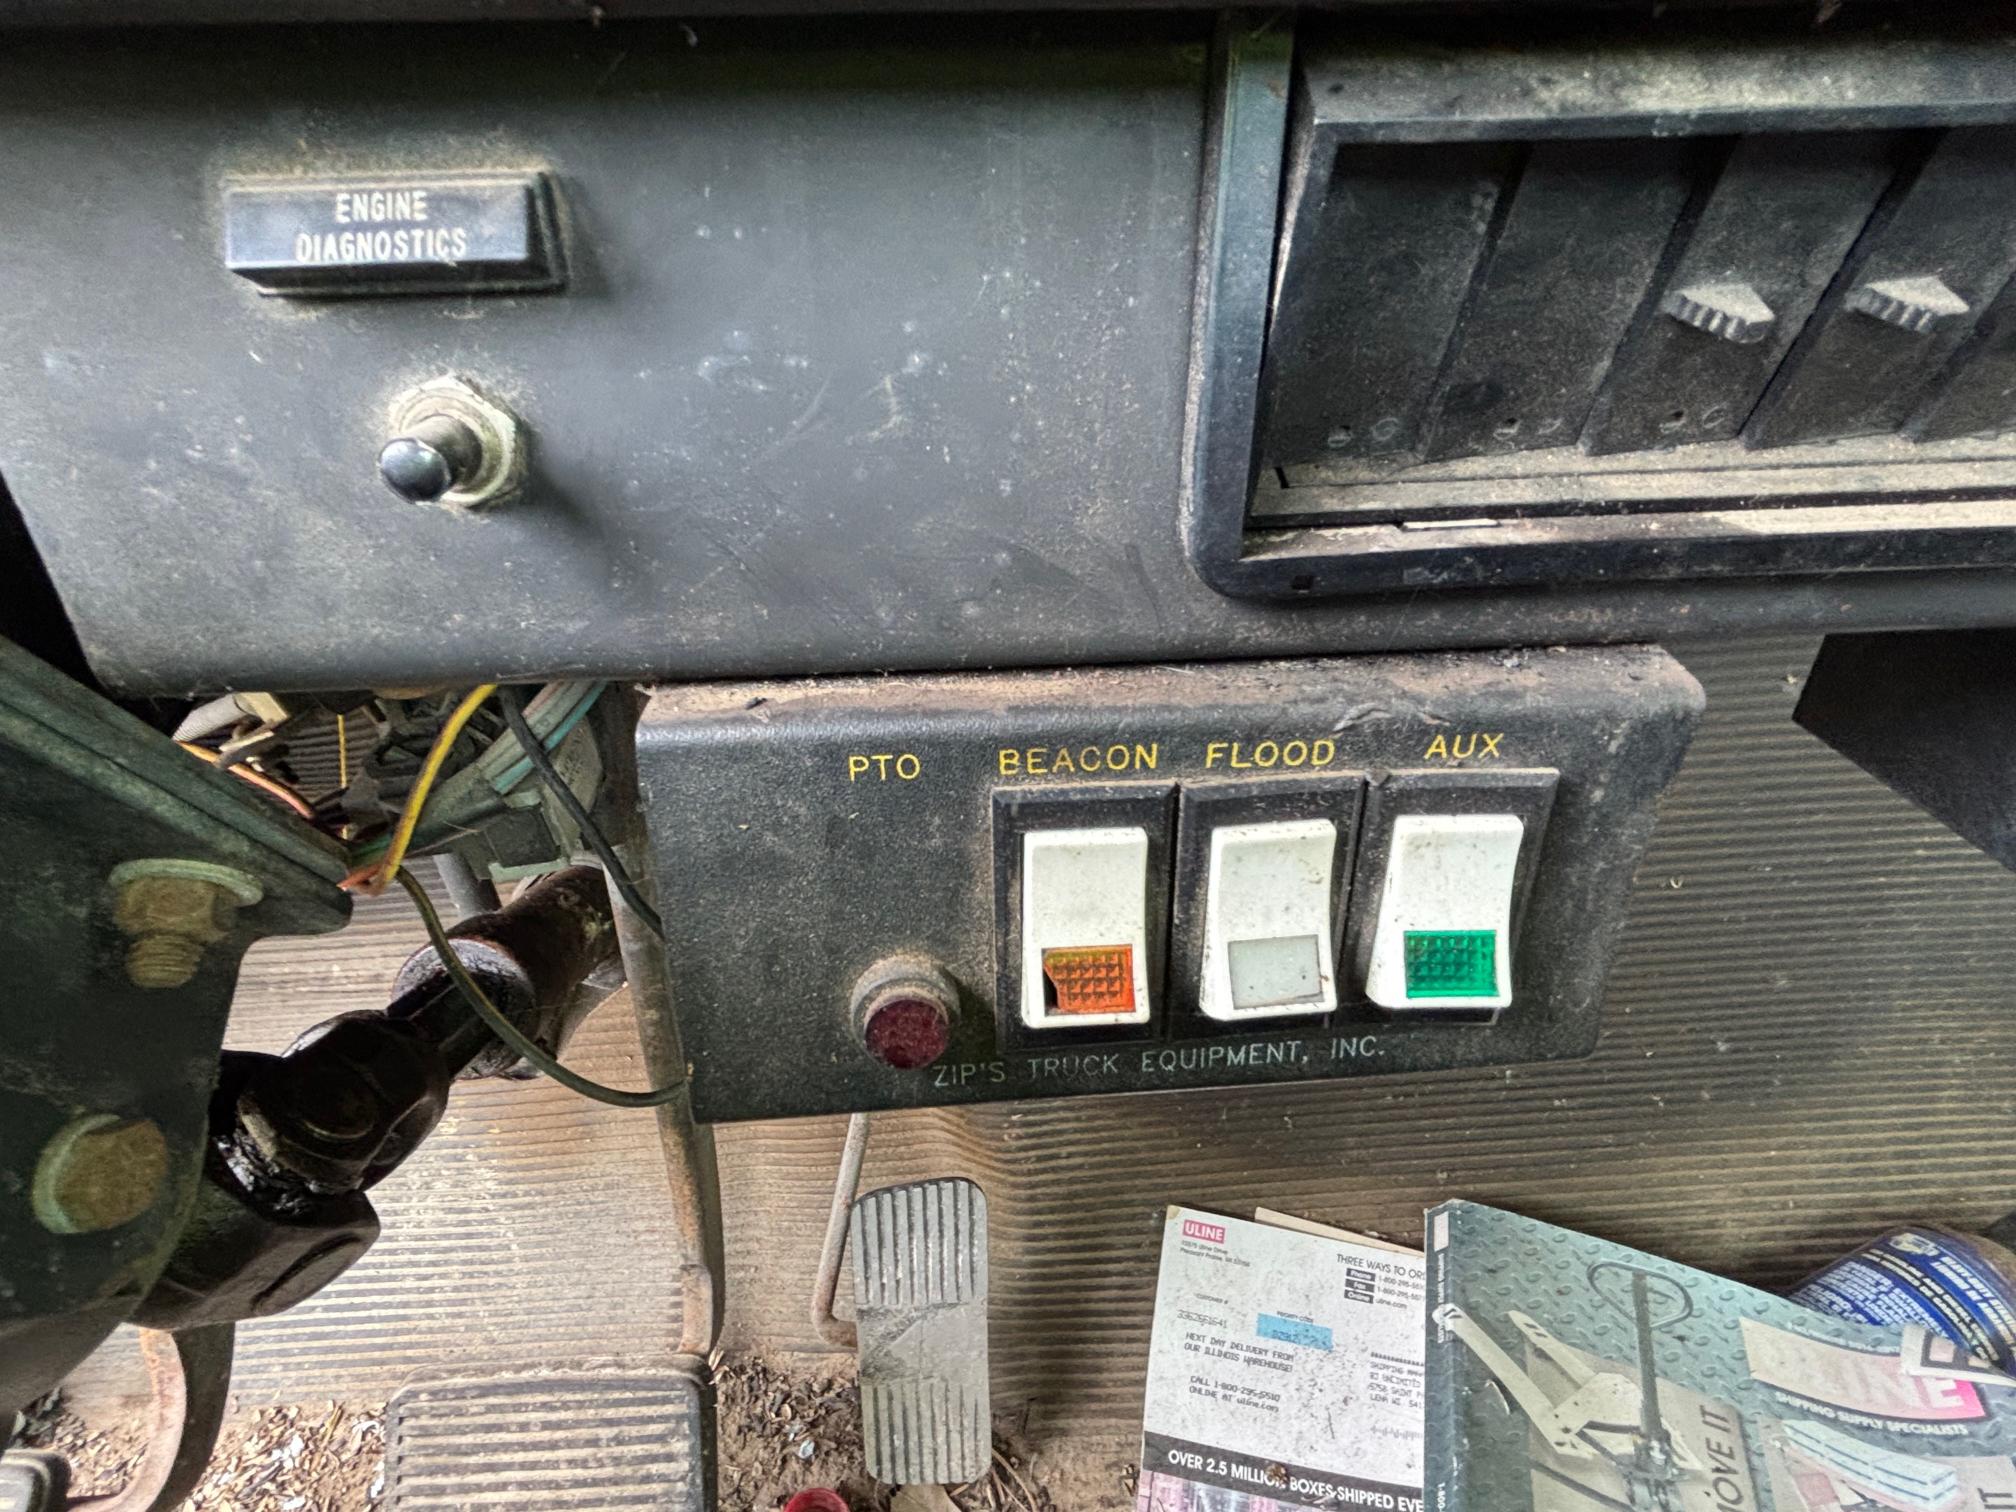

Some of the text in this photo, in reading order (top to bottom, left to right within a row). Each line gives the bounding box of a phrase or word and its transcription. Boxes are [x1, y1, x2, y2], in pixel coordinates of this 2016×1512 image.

[335, 190, 428, 224] ENGINE
[294, 227, 468, 264] DIAGNOSTICS
[999, 743, 1159, 776] BEACON
[1205, 738, 1336, 768] FLOOD
[1424, 732, 1504, 760] AUX
[849, 754, 921, 782] PTO
[933, 1036, 1386, 1088] ZIP'S TRUCK EQUIPMENT, INC.
[1184, 1221, 1224, 1241] ULINE
[1337, 1254, 1364, 1268] THREE
[1366, 1260, 1391, 1274] WAYS
[1394, 1266, 1406, 1276] TO
[1184, 1342, 1200, 1352] OUR
[1204, 1346, 1239, 1361] ILLINOIS
[1186, 1332, 1294, 1362] NEXT DAY DELIVERY FROM
[1189, 1386, 1217, 1399] ONLINE
[1190, 1375, 1210, 1387] CALL
[1699, 1404, 1731, 1433] IT
[1168, 1450, 1203, 1469] OVER
[1206, 1458, 1228, 1476] 2.5
[1290, 1476, 1335, 1497] BOXES
[1337, 1485, 1395, 1509] SHIPPED
